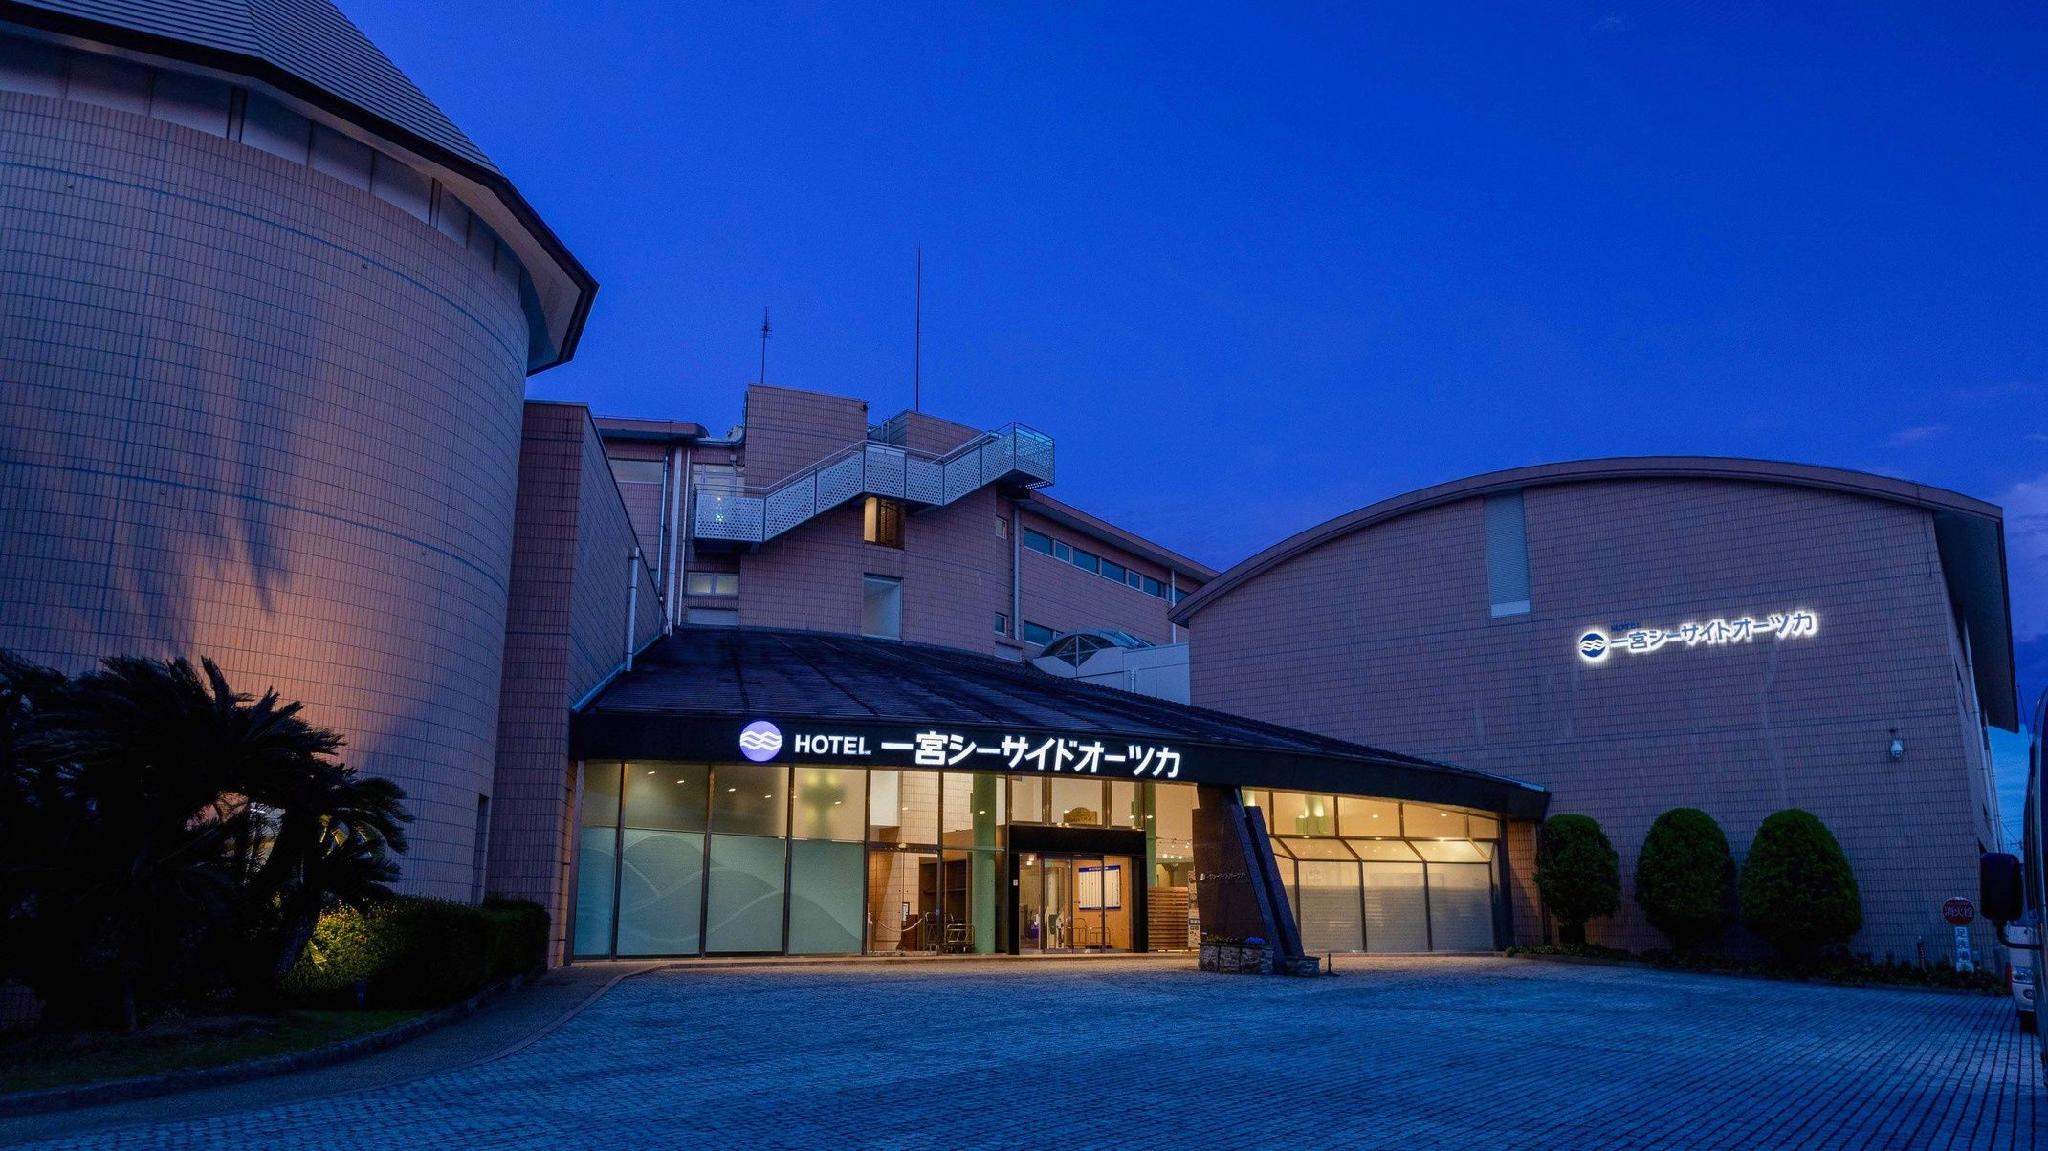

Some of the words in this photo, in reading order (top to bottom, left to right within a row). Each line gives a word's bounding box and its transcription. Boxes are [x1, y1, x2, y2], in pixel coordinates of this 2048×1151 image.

[795, 734, 872, 755] HOTEL
[881, 731, 1181, 778] 一宮シーサイドオーツカ
